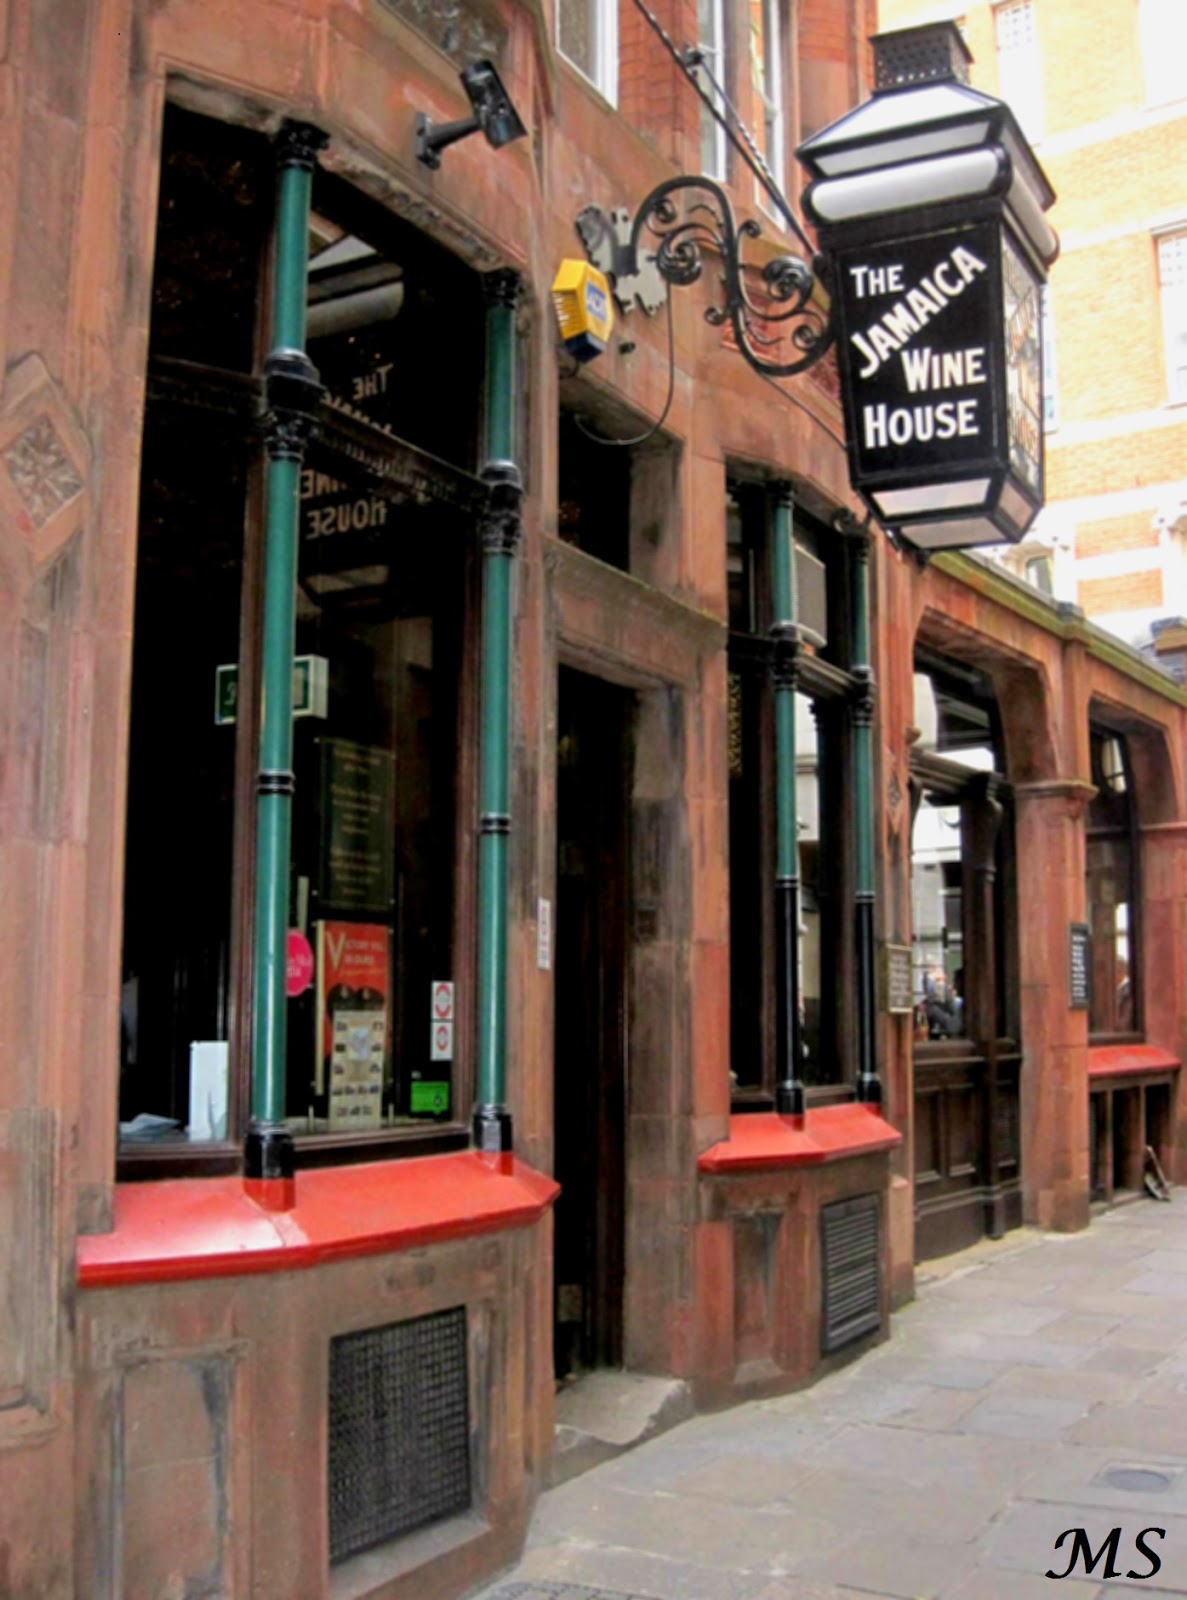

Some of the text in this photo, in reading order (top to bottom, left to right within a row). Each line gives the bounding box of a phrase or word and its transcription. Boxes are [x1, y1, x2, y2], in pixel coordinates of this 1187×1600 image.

[850, 264, 904, 298] THE
[850, 245, 988, 379] JAMAICA
[901, 347, 987, 393] WINE
[863, 399, 979, 449] HOUSE
